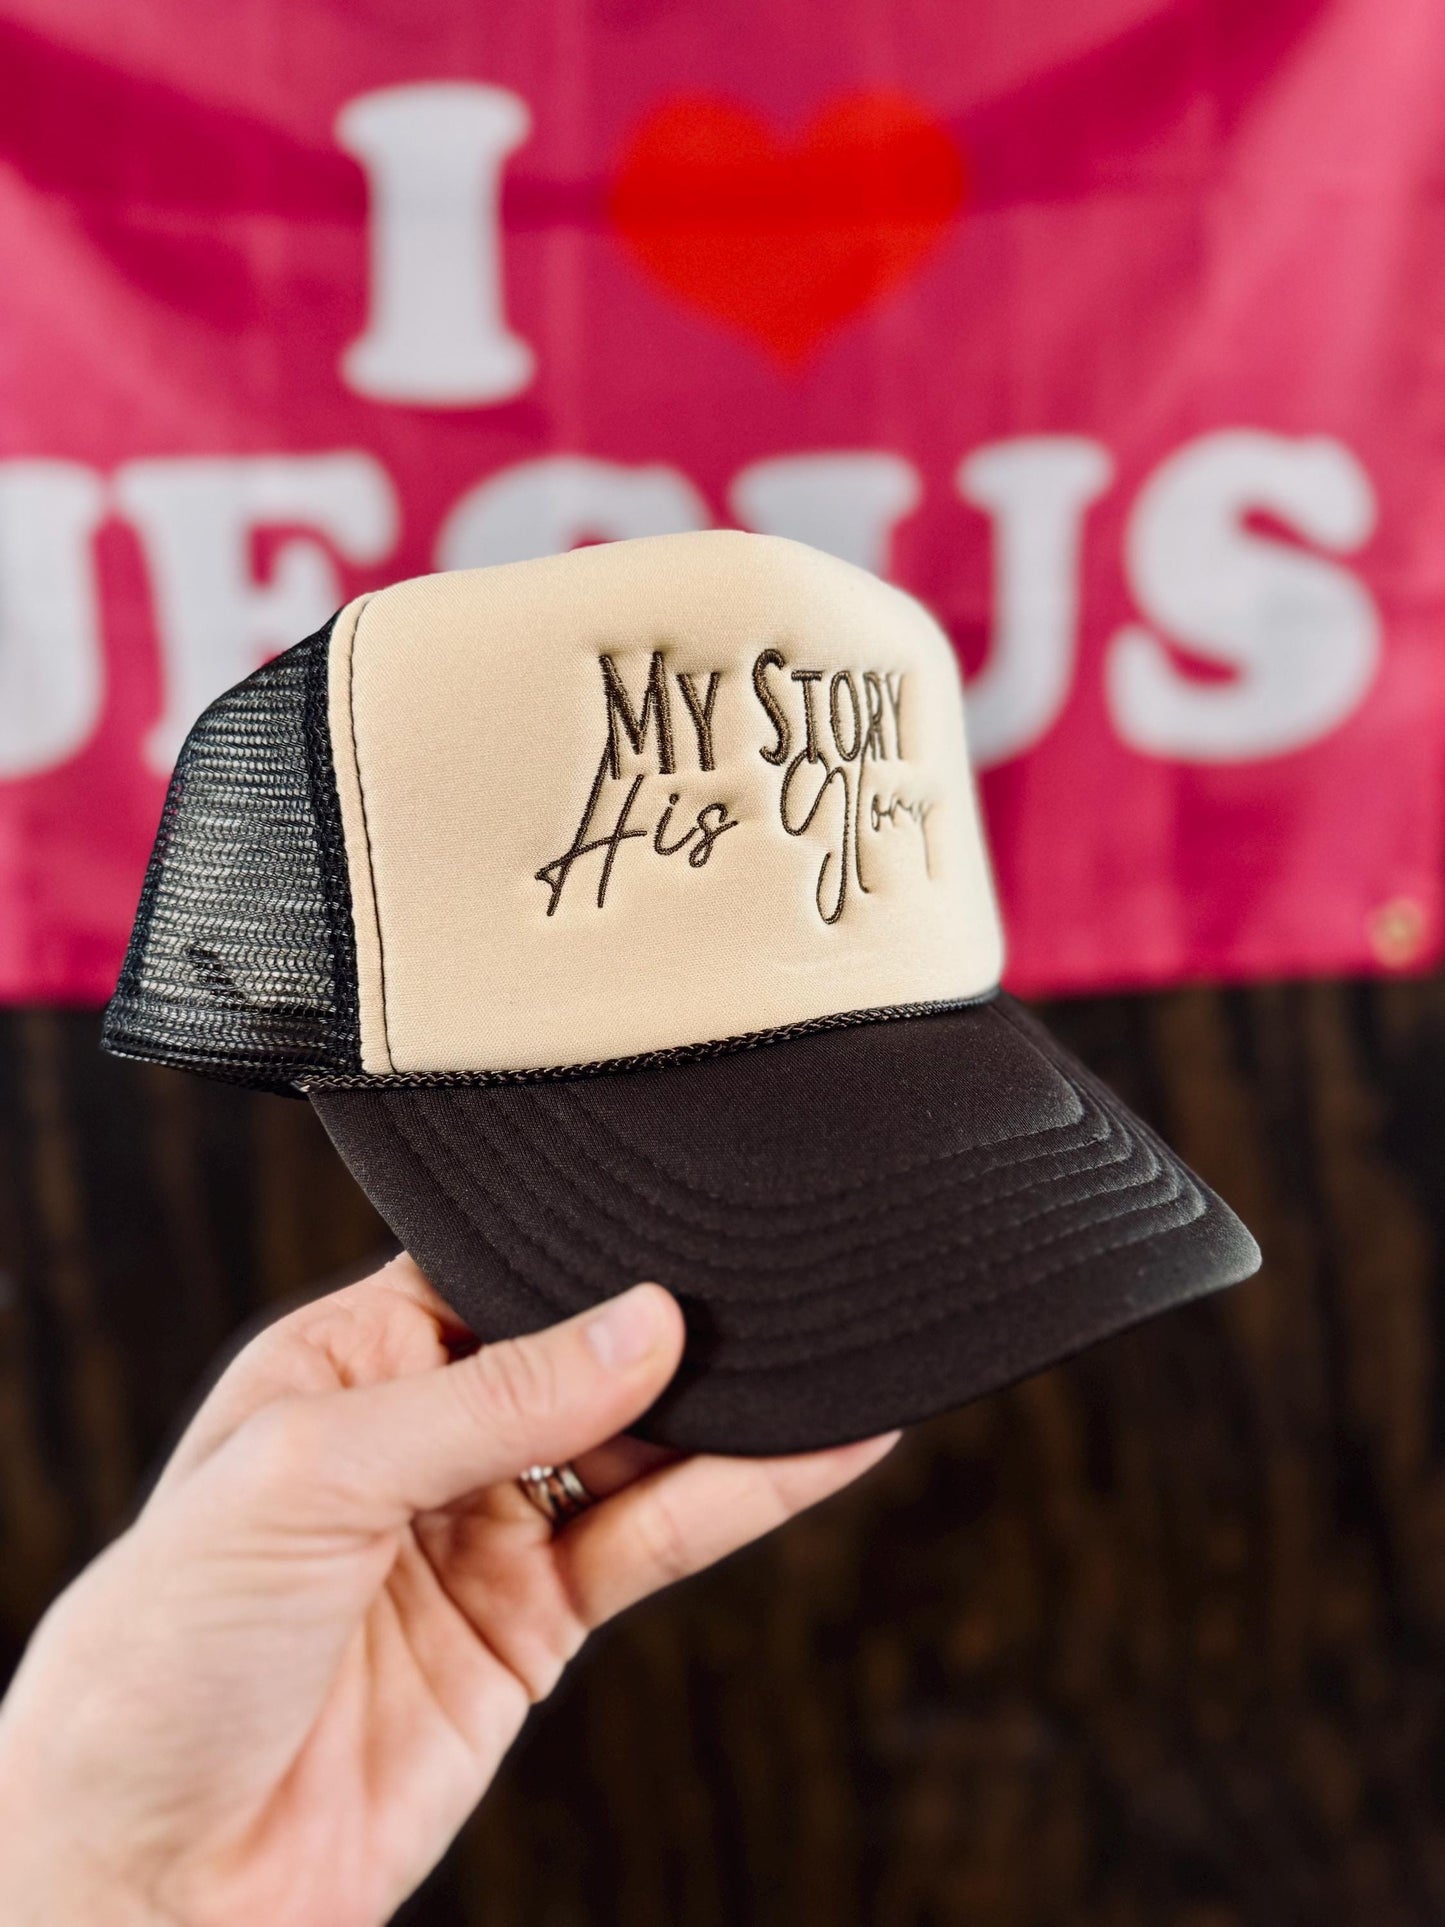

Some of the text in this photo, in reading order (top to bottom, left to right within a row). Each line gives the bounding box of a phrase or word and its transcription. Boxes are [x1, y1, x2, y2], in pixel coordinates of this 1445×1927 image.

[334, 81, 535, 406] I
[599, 648, 905, 779] MY STORY
[535, 738, 934, 925] His Glory
